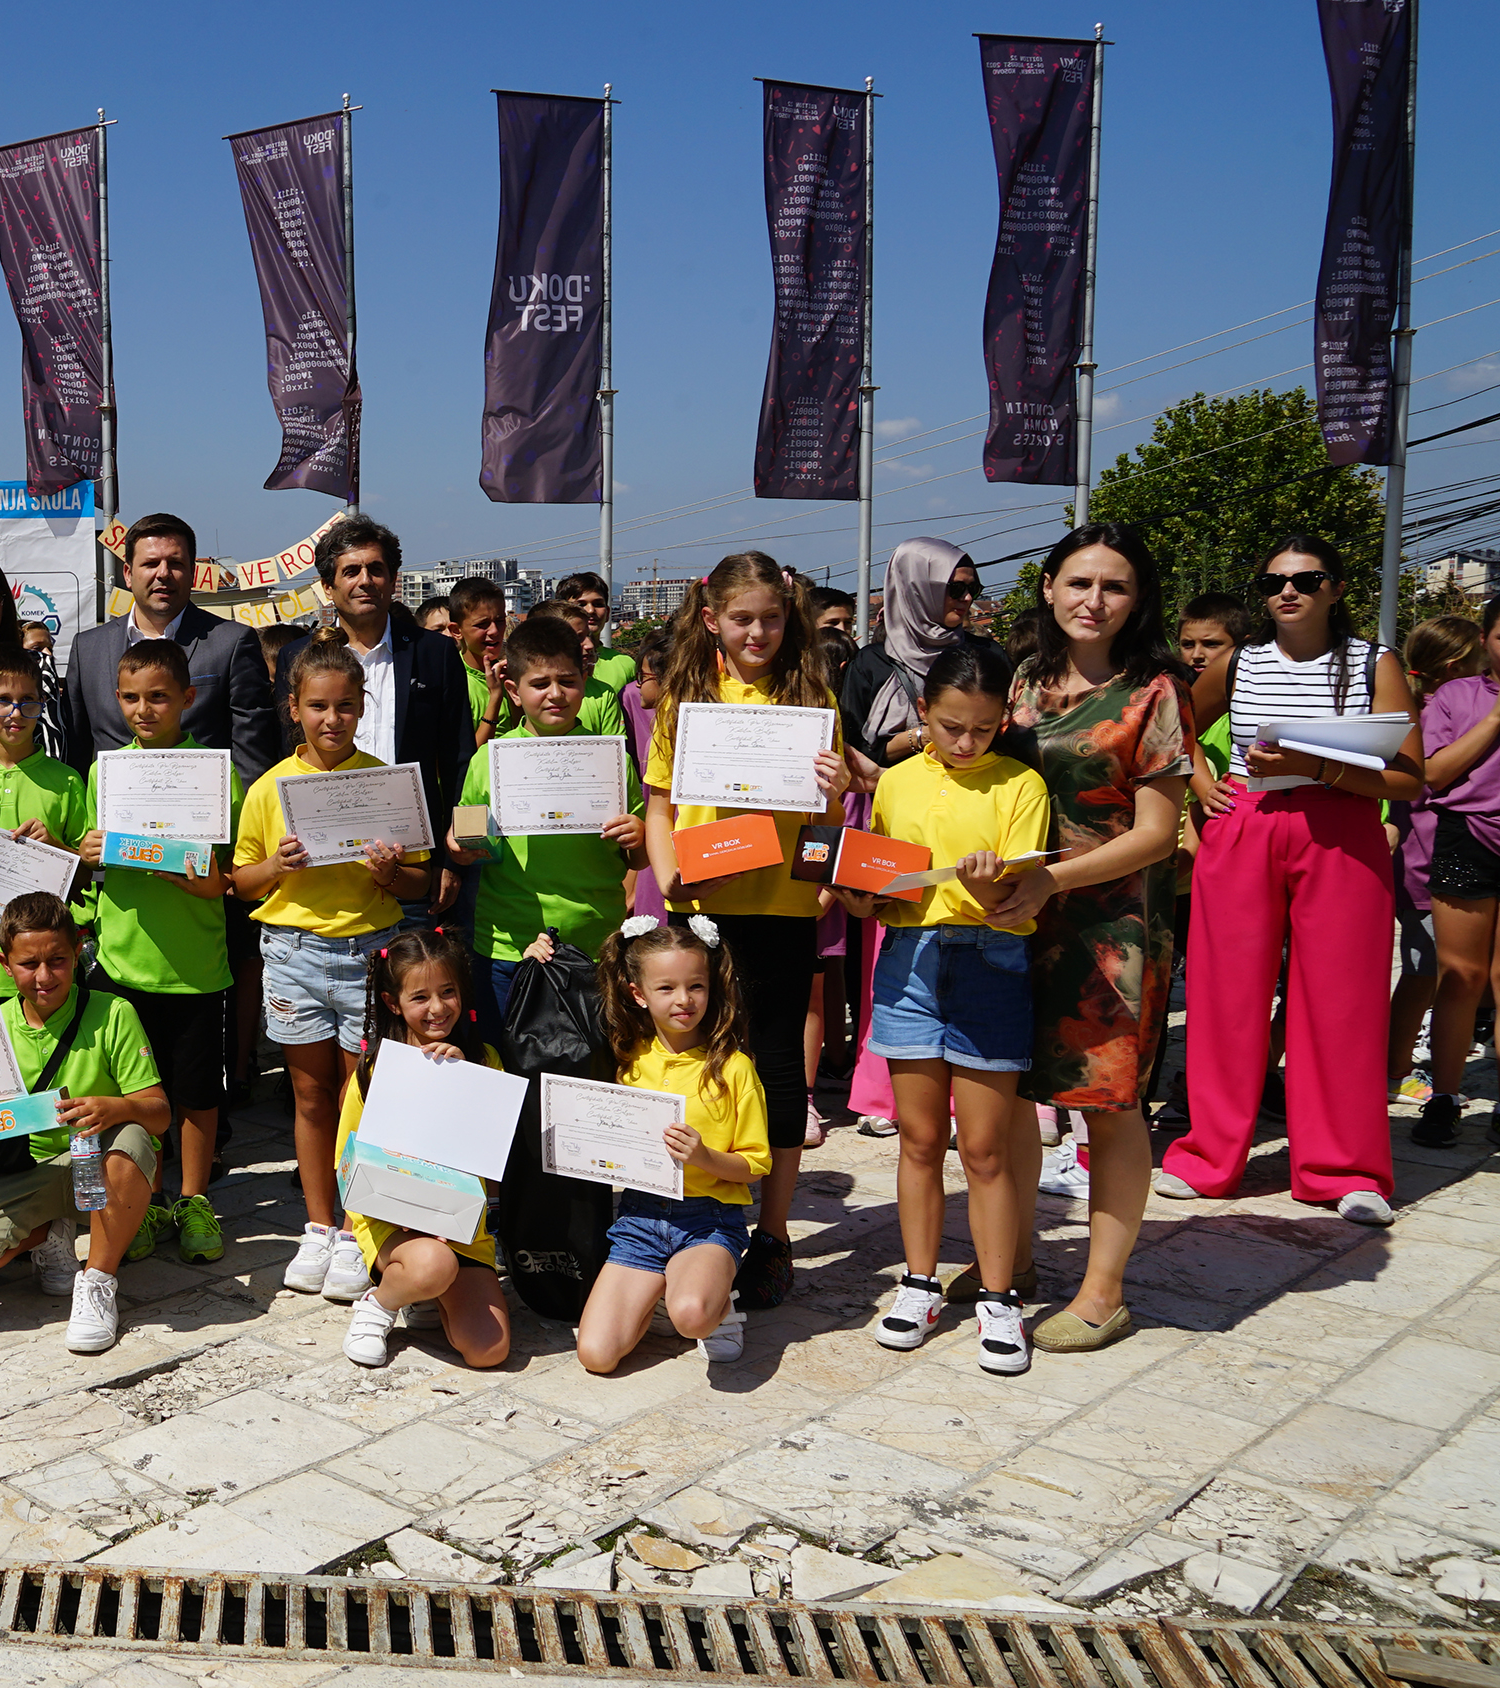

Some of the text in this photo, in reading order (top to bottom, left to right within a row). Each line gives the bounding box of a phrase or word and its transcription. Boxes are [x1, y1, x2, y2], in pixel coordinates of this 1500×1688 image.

[120, 838, 152, 848] KOMEK
[724, 838, 740, 847] BOX
[882, 859, 896, 868] BOX
